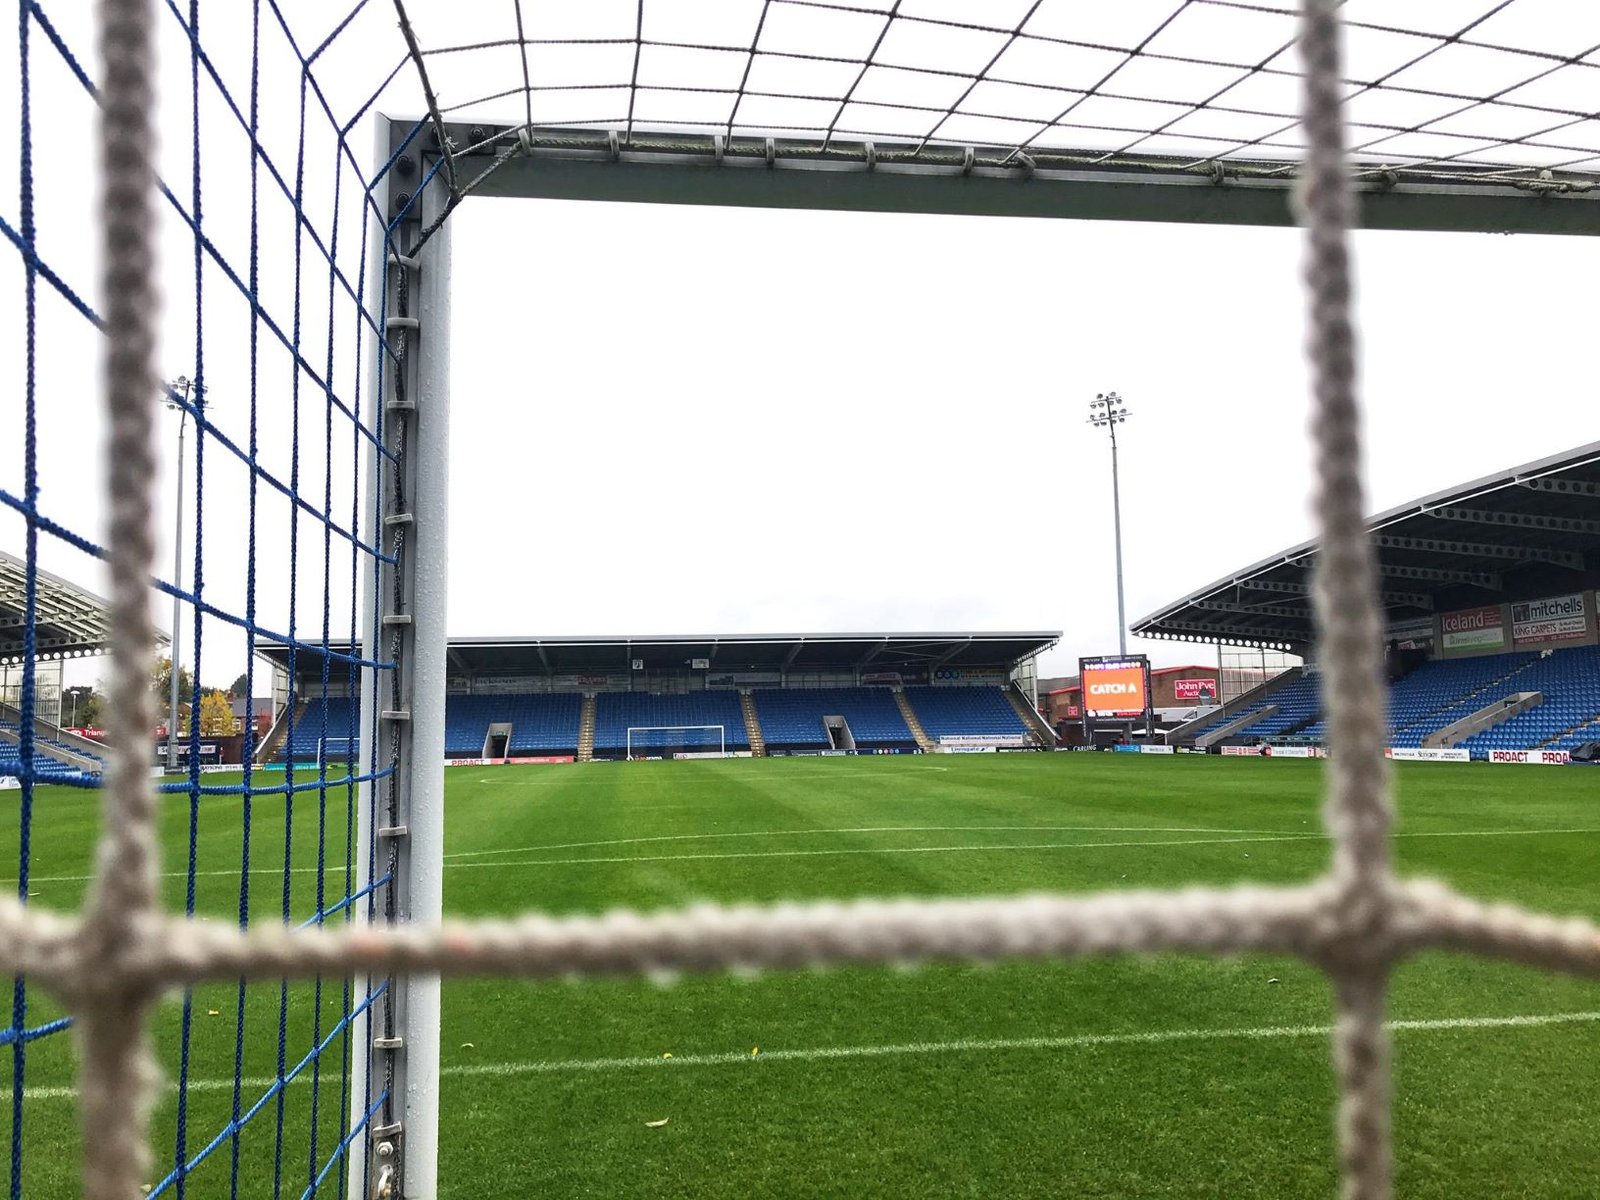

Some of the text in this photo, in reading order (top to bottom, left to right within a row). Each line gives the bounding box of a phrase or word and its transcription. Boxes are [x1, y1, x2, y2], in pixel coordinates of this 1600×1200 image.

[1531, 598, 1583, 617] mitchells
[1442, 611, 1484, 632] Iceland
[1090, 682, 1137, 695] CATCH A
[1176, 682, 1198, 690] John
[452, 759, 485, 767] PROACT
[1493, 751, 1573, 763] PROACT PROA
